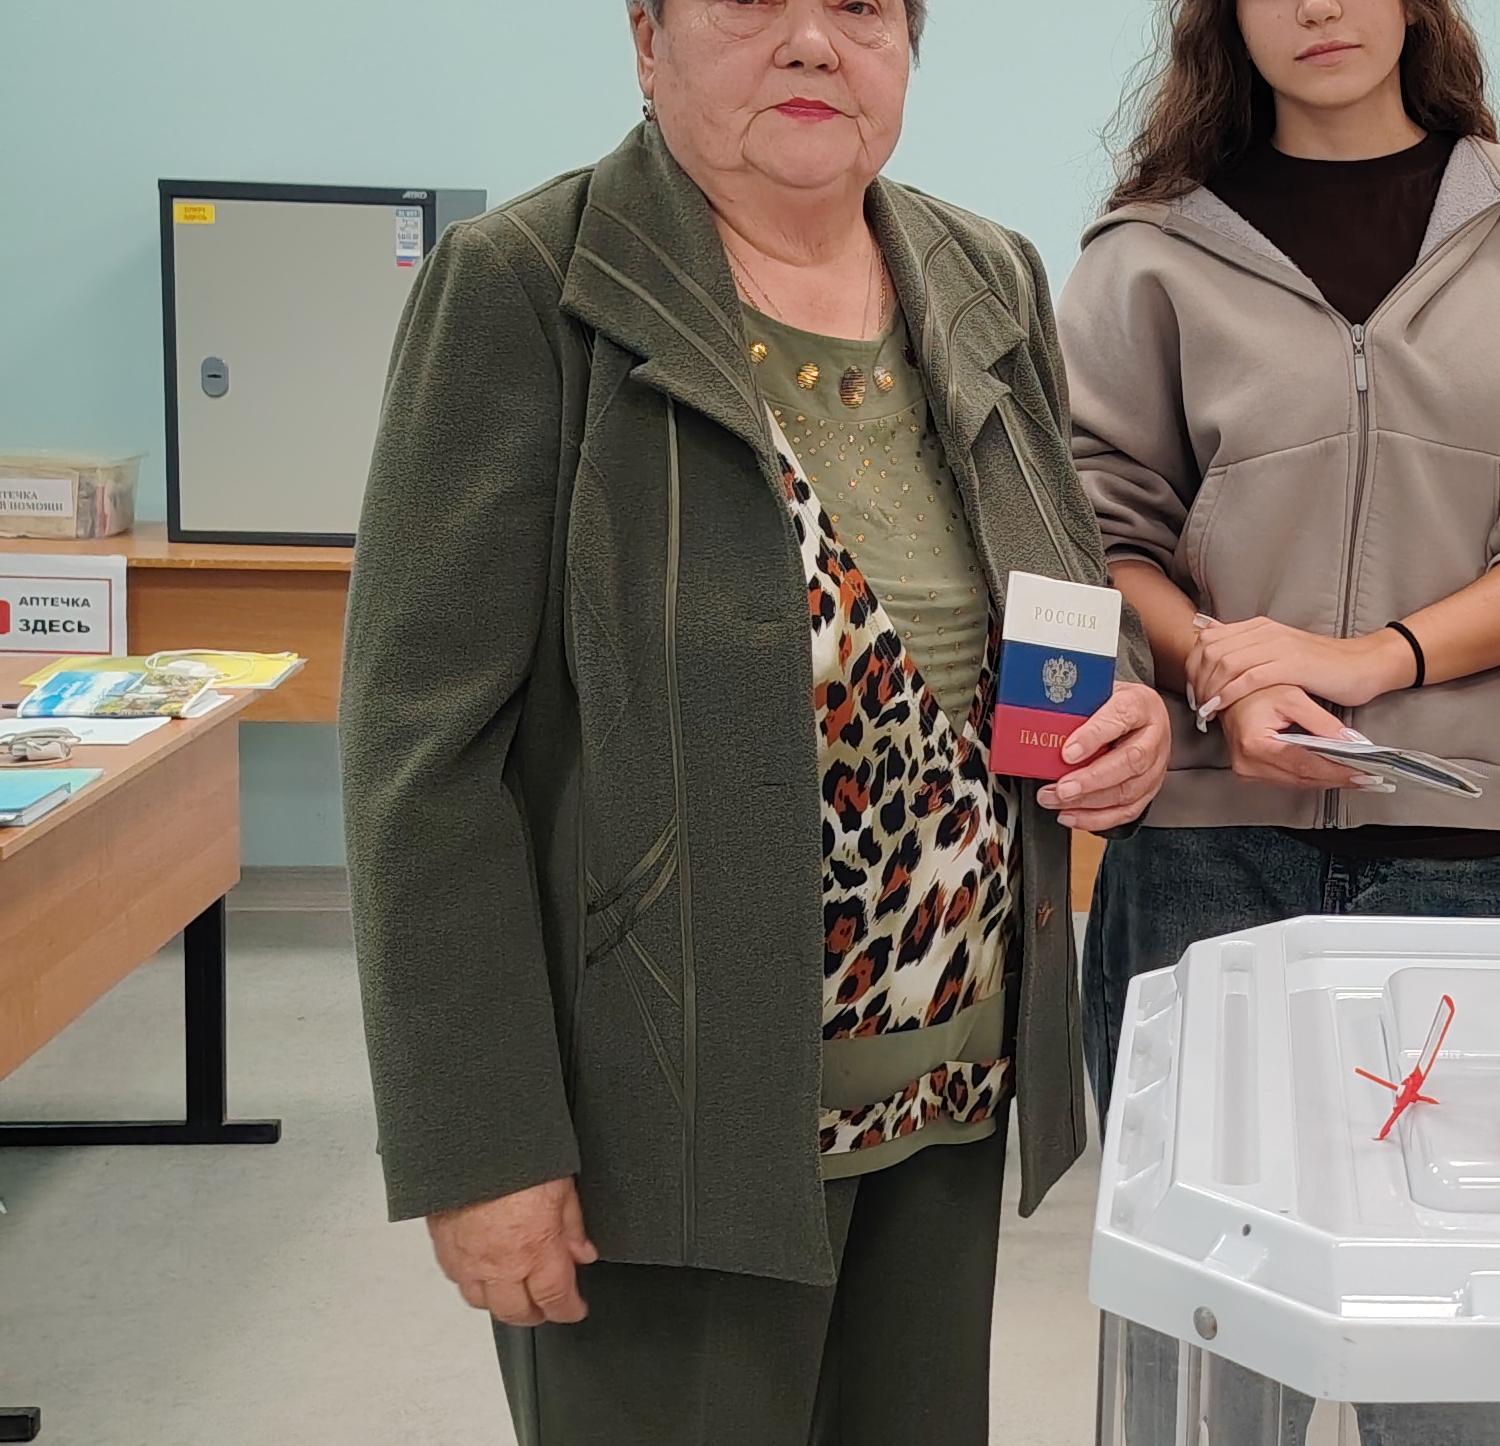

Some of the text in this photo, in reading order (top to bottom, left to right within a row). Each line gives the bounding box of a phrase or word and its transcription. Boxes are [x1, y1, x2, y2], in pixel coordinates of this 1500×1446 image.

[0, 490, 38, 500] ТЕЧКА
[19, 596, 91, 608] АПТЕЧКА
[18, 618, 91, 635] ЗДЕСЬ
[1034, 606, 1098, 630] РОССИЯ
[1020, 729, 1066, 748] ПАСП
